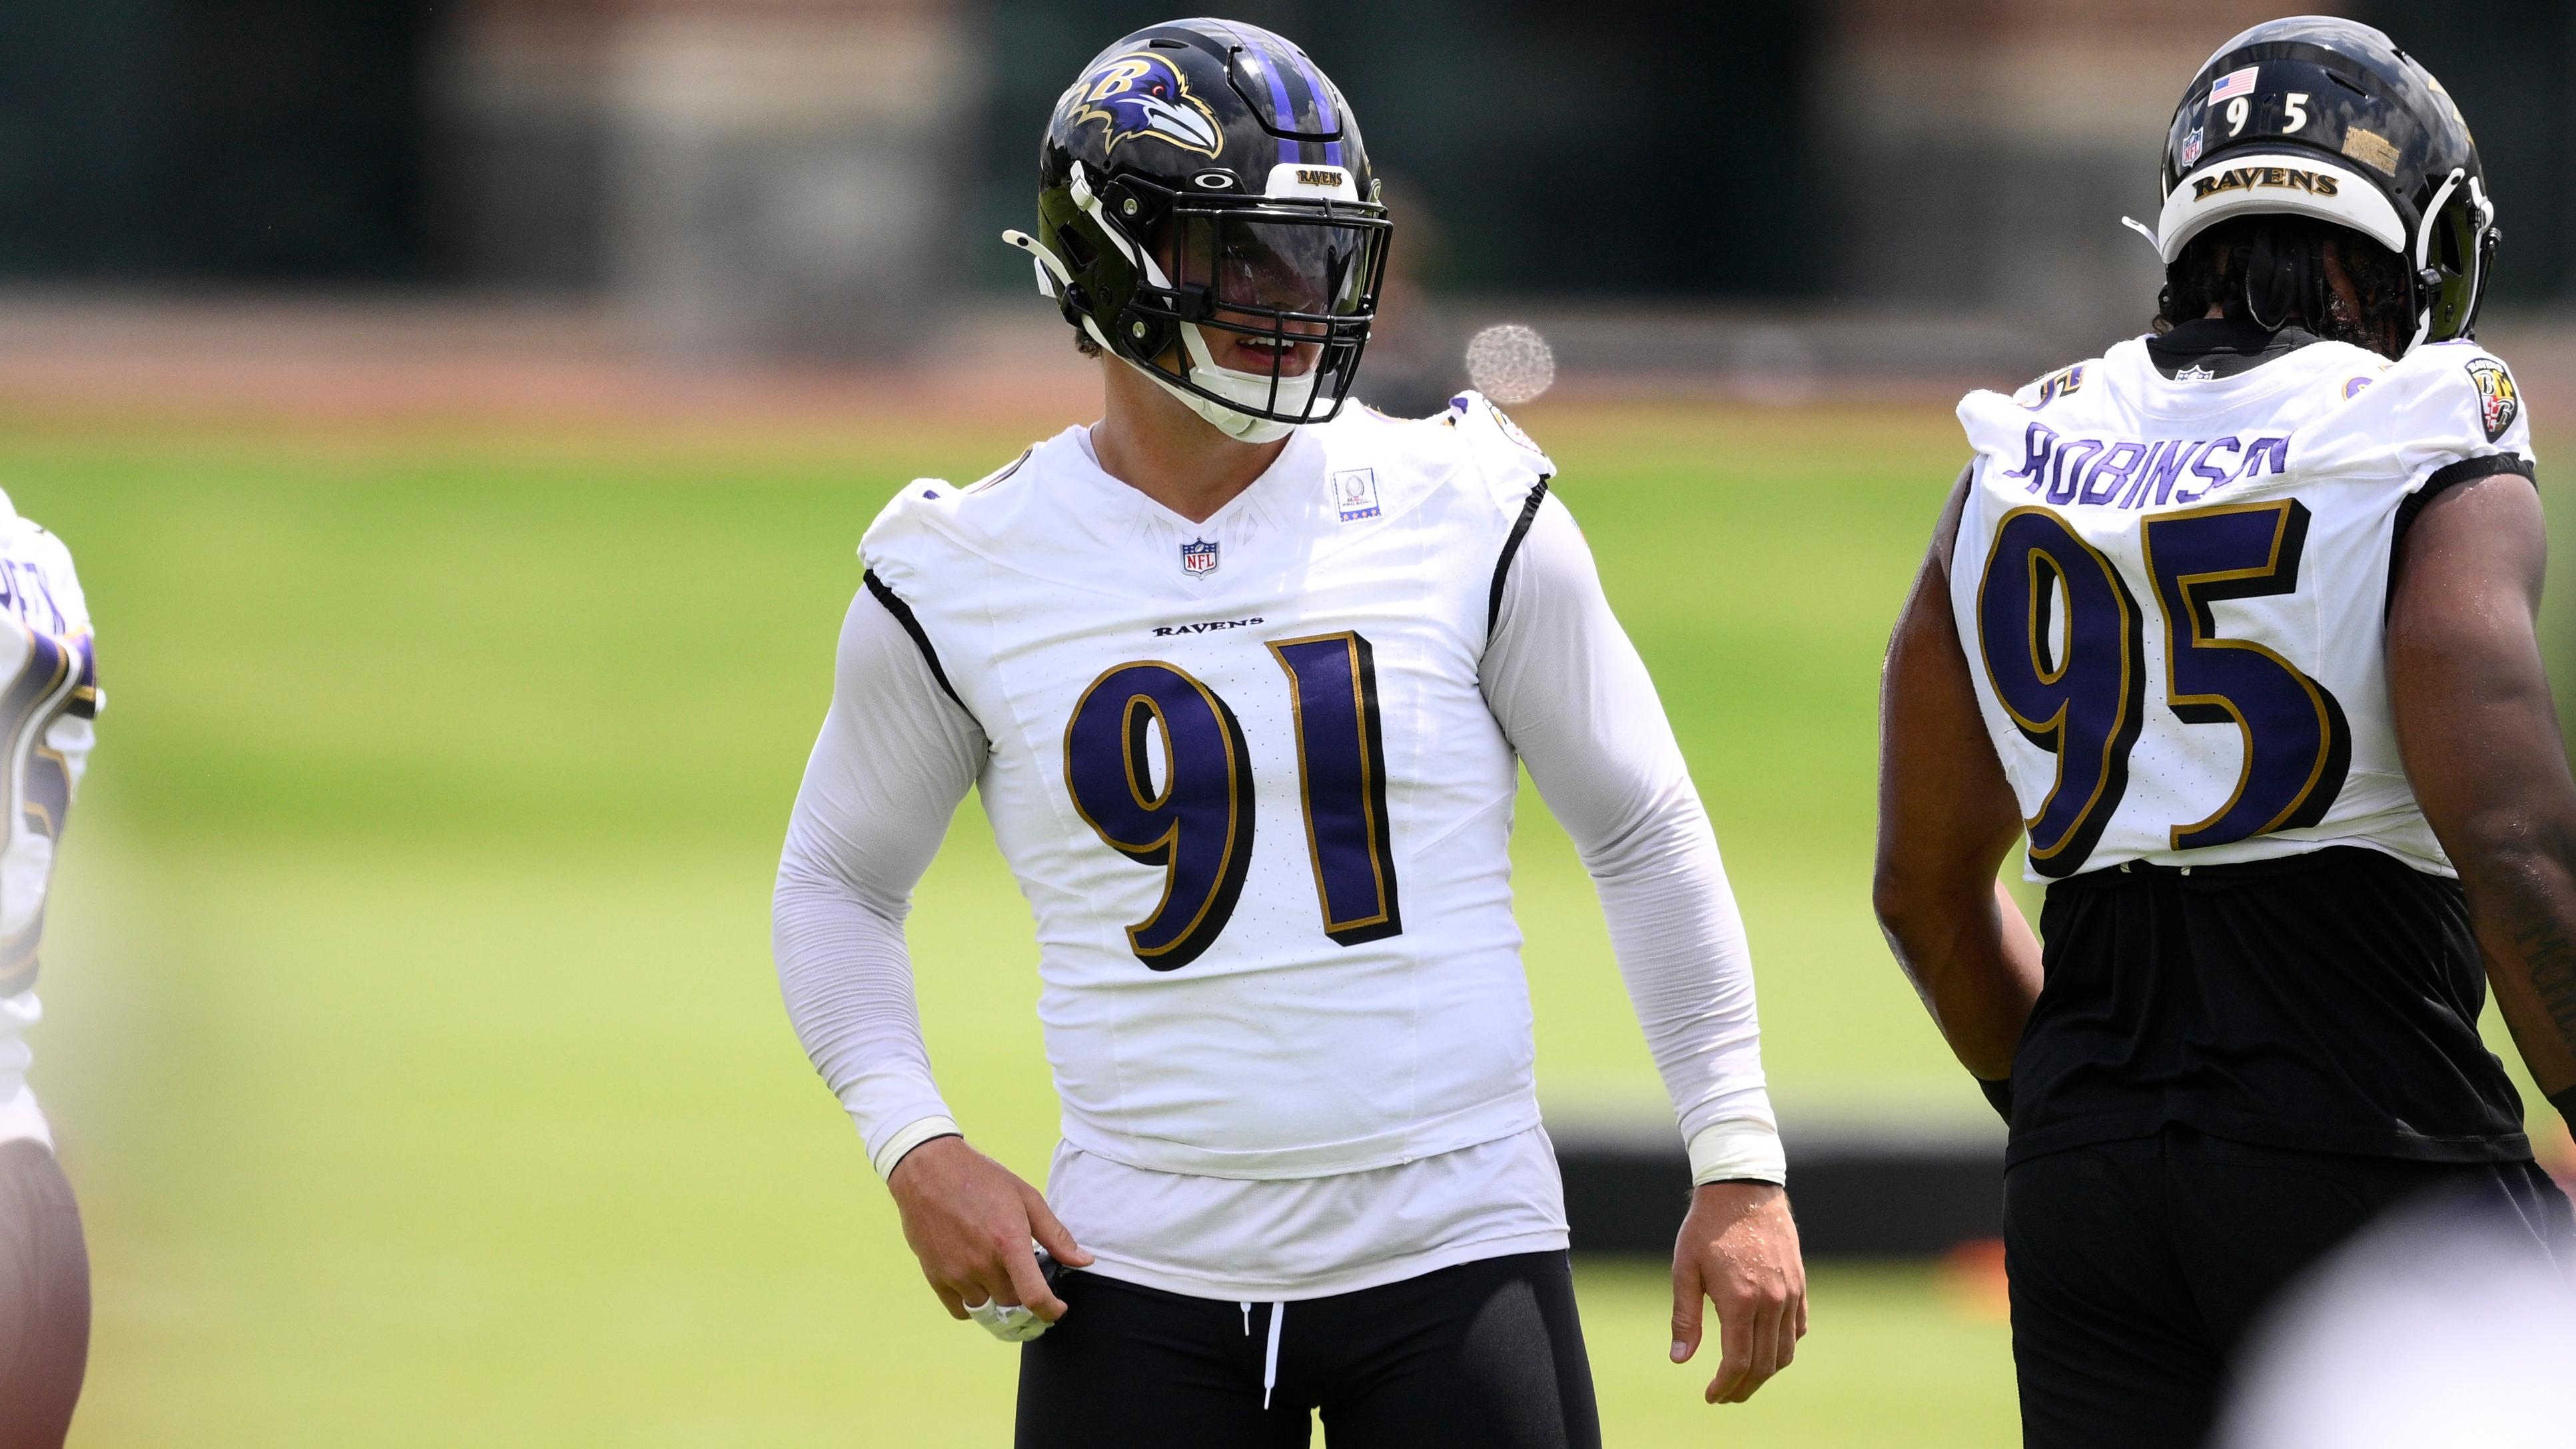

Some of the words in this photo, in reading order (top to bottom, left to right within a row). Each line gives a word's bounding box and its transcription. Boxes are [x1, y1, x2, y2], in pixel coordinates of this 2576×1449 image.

[2184, 142, 2200, 163] NFL
[1295, 169, 1343, 187] RAVENS
[2191, 167, 2340, 203] RAVENS
[1186, 554, 1214, 570] NFL
[1152, 617, 1265, 637] RAVENS
[1976, 497, 2352, 879] 95
[1063, 630, 1403, 972] 91
